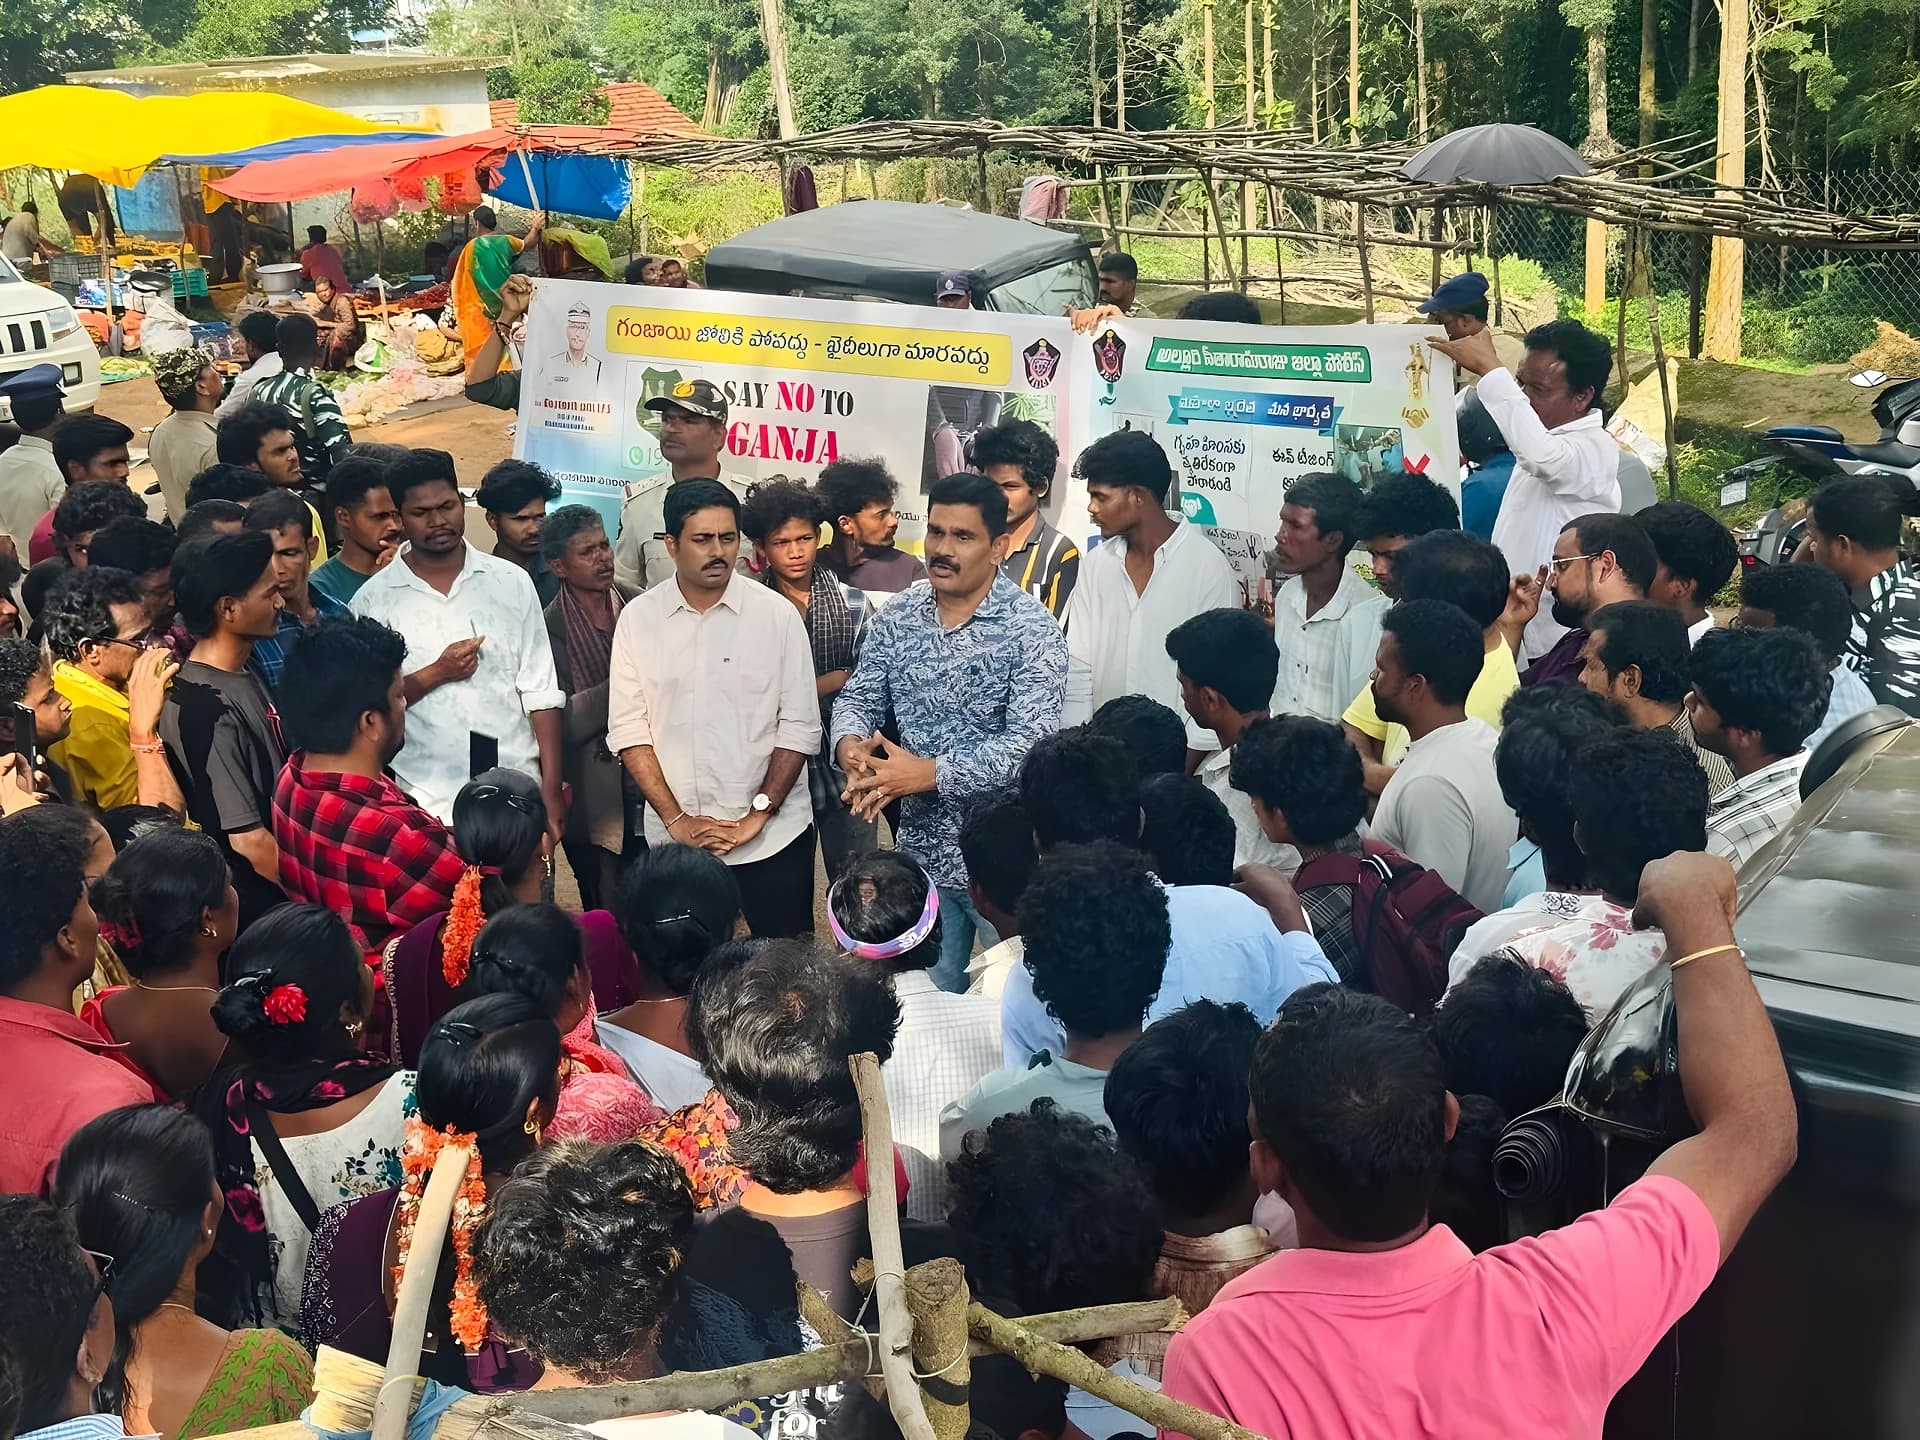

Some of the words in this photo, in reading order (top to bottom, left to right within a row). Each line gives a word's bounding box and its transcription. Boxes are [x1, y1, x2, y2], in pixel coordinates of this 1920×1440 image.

[616, 317, 691, 341] గంజాయి
[749, 330, 809, 360] పోవద్దు
[826, 335, 901, 360] ఖైదీలుగా
[904, 342, 990, 374] మారవద్దు
[723, 380, 769, 409] SAY
[774, 380, 815, 413] NO
[821, 388, 855, 417] TO
[726, 420, 840, 465] GANJA
[1202, 434, 1246, 455] హింసకు
